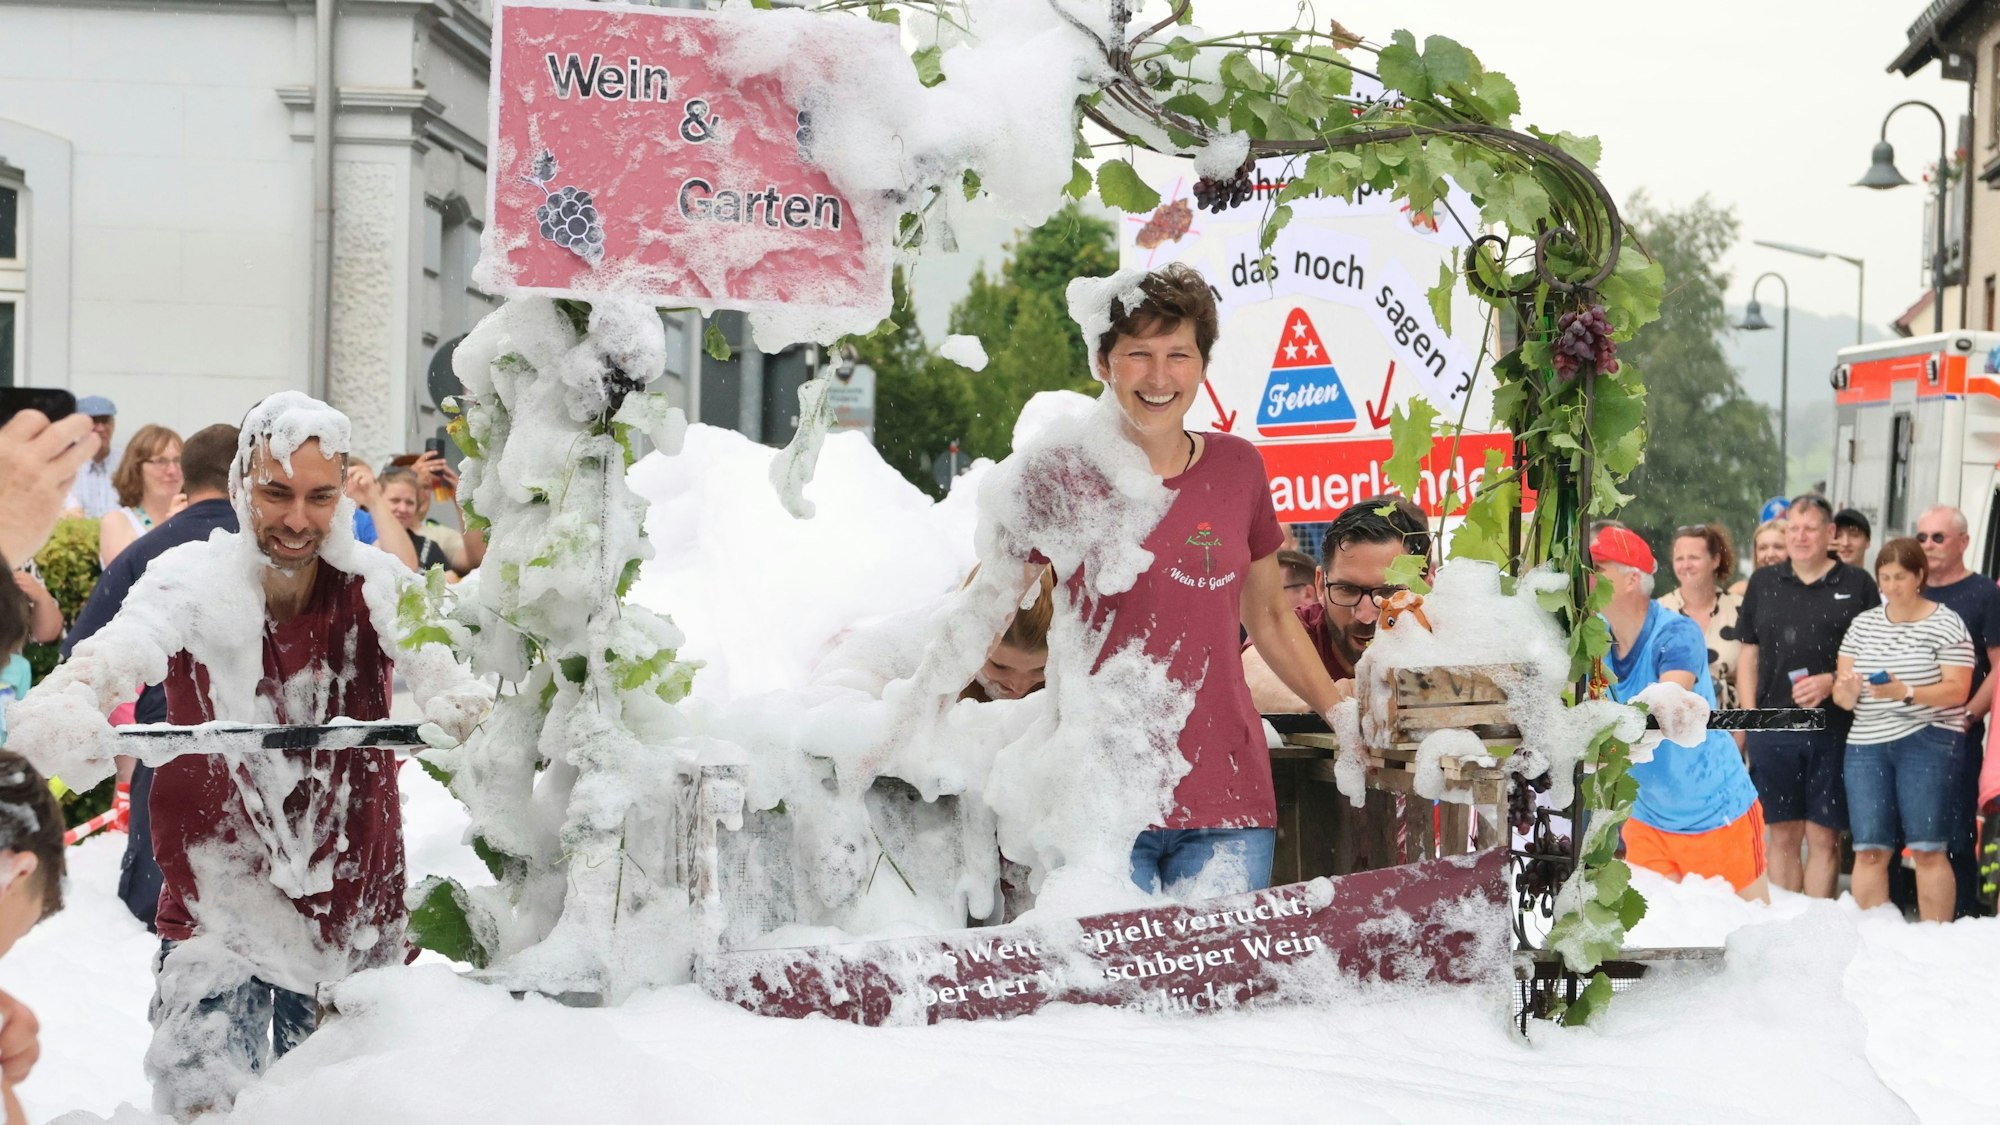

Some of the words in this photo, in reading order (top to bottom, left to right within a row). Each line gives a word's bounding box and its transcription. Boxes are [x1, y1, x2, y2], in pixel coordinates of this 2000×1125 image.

[547, 54, 669, 101] Wein
[679, 100, 720, 143] &
[678, 178, 841, 230] Garten
[1232, 253, 1280, 287] das
[1294, 250, 1365, 289] noch
[1375, 285, 1447, 378] sagen
[1450, 371, 1471, 400] ?
[1267, 382, 1340, 417] Fetten
[1170, 567, 1196, 587] Wein
[1197, 577, 1207, 588] &
[1209, 571, 1236, 591] Garten
[966, 939, 1042, 964] Wett
[1081, 918, 1166, 954] spielt
[916, 982, 970, 1006] ber
[978, 976, 1029, 999] der
[1241, 931, 1322, 960] Wein
